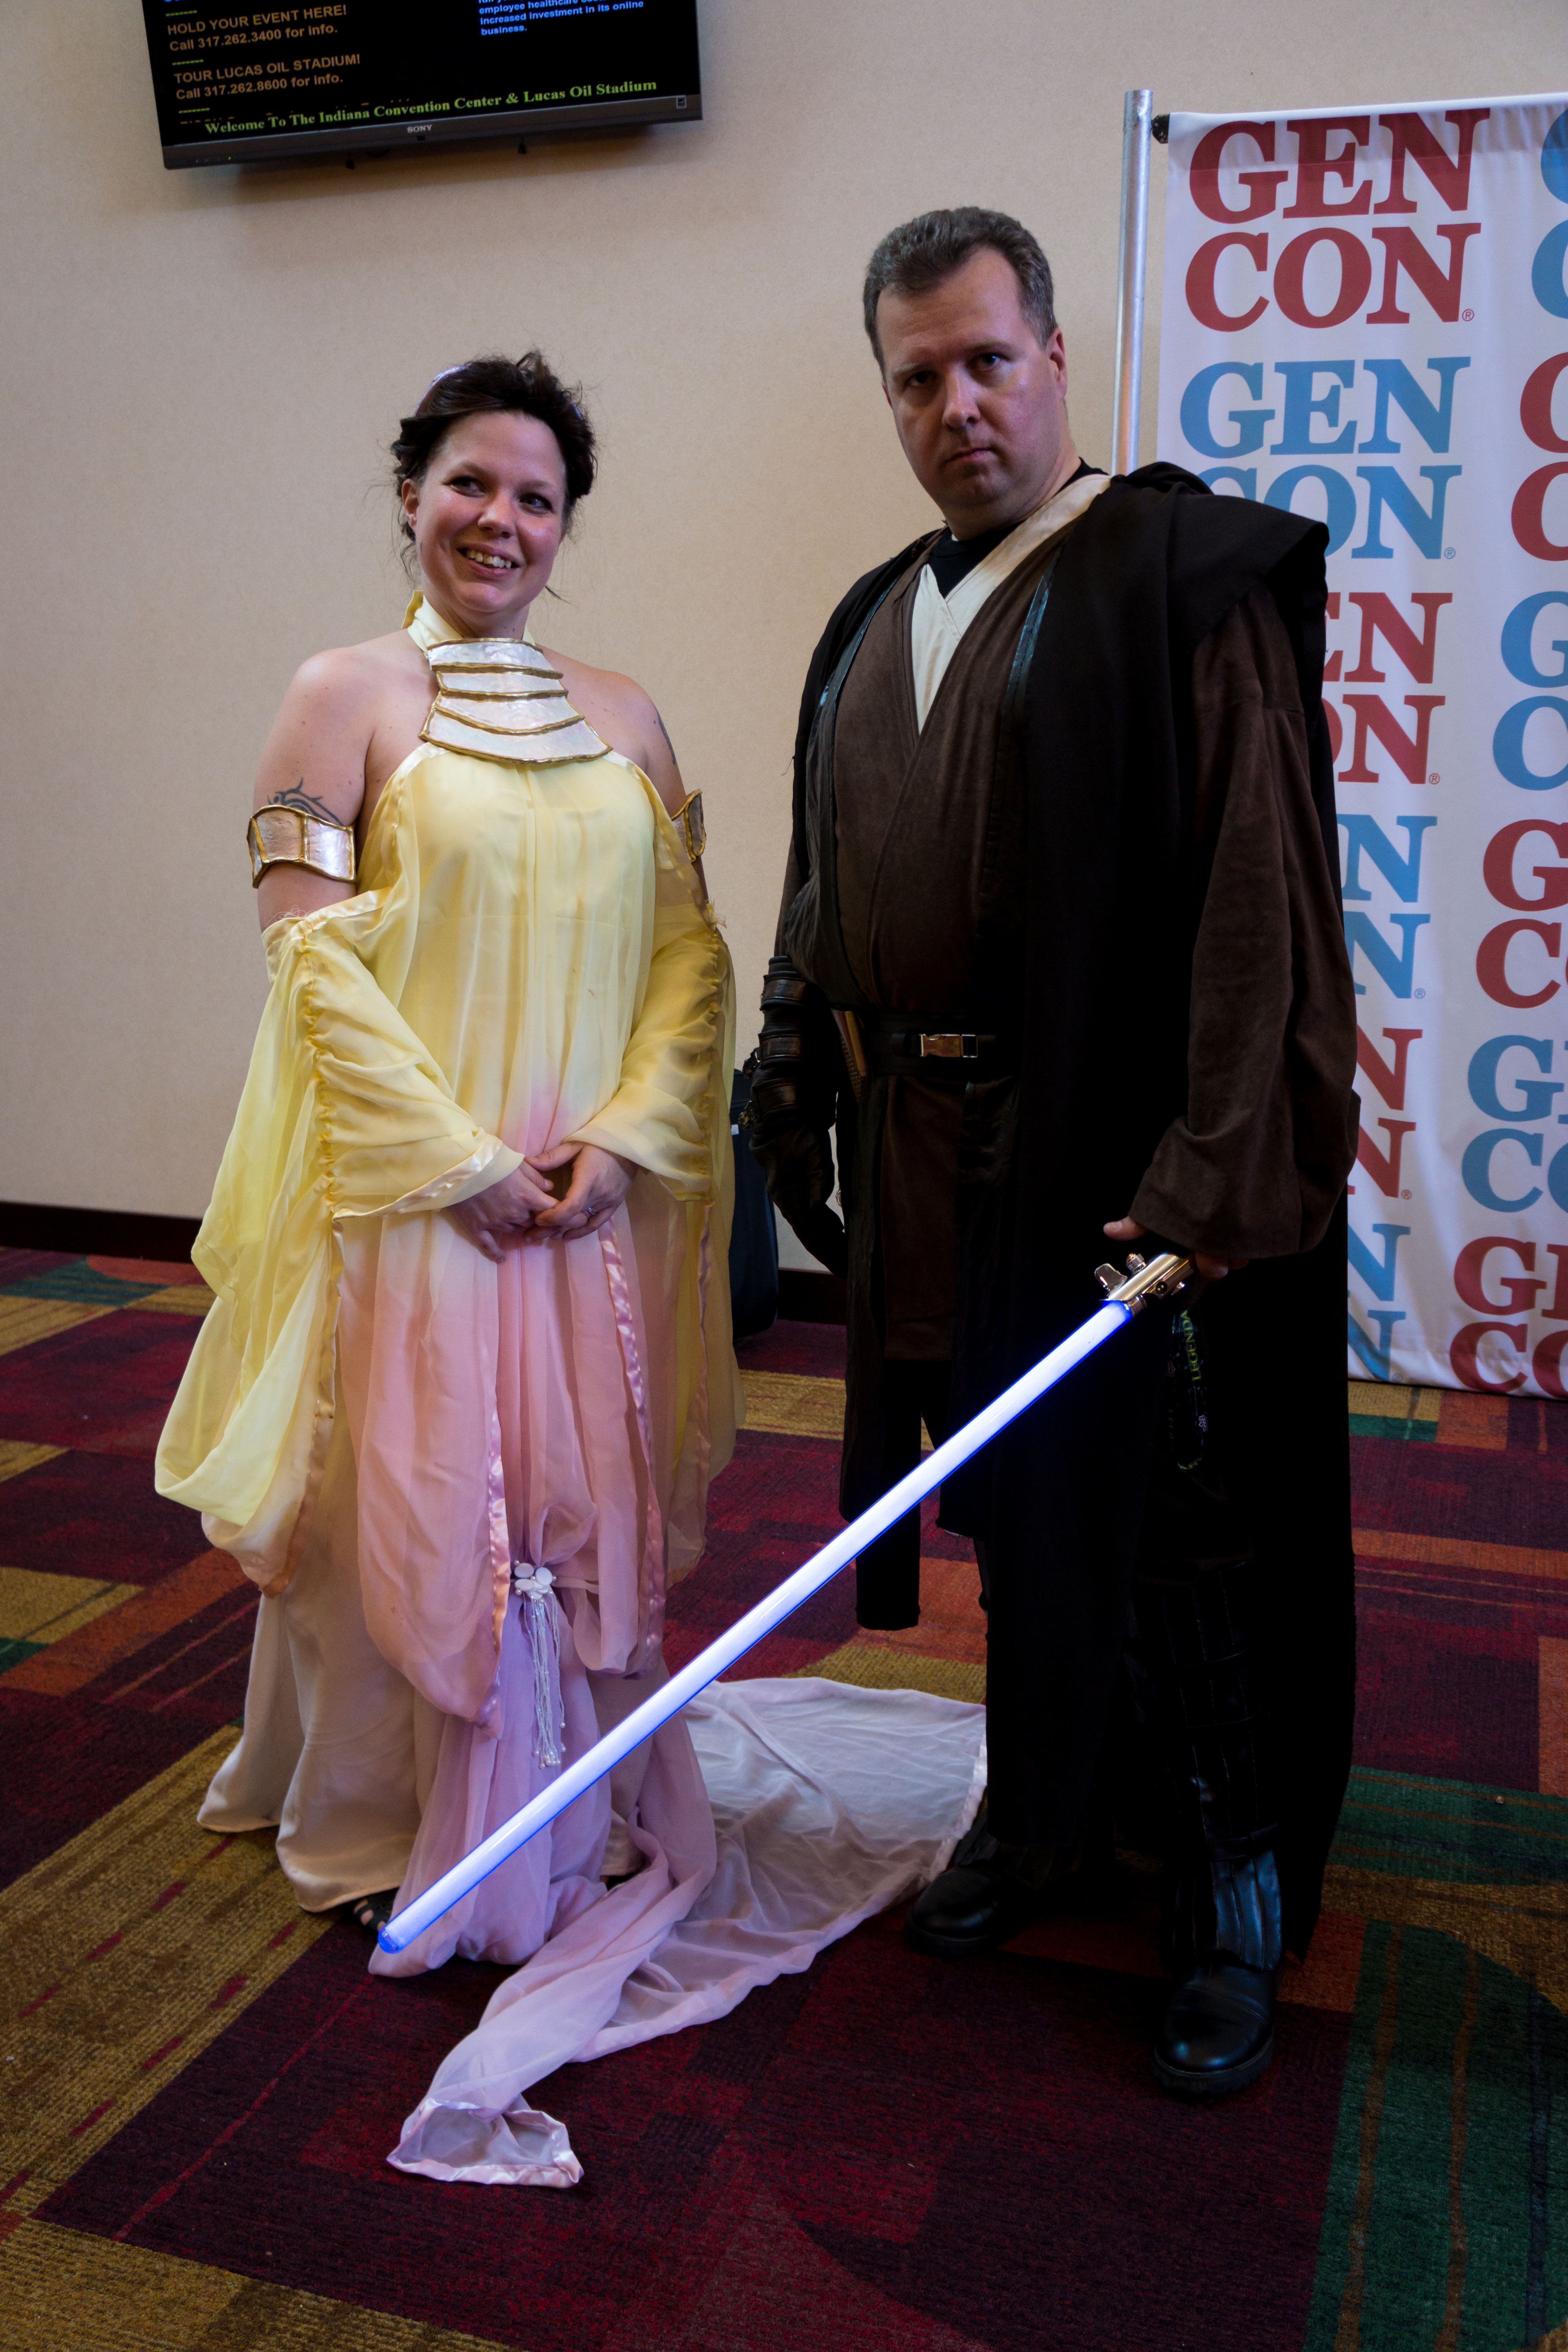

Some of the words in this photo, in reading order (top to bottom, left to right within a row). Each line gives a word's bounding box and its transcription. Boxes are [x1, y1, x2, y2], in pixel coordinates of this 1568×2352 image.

[168, 21, 205, 35] HOLD
[209, 16, 249, 29] YOUR
[253, 10, 299, 25] EVENT
[303, 4, 347, 19] HERE!
[479, 3, 526, 15] employee
[480, 13, 527, 25] increased
[529, 6, 583, 20] investment
[584, 5, 595, 14] in
[597, 4, 610, 13] its
[612, 0, 644, 11] online
[170, 38, 194, 51] Call
[198, 29, 281, 47] 317.262.3400
[285, 28, 305, 38] for
[309, 24, 338, 35] info.
[481, 24, 527, 36] business.
[174, 70, 212, 83] TOUR
[216, 64, 263, 79] LUCAS
[267, 62, 290, 73] OIL
[293, 54, 360, 70] STADIUM!
[176, 88, 200, 99] Call
[204, 78, 287, 96] 317.262.8600
[291, 77, 310, 87] for
[314, 73, 343, 85] info.
[205, 122, 264, 134] Welcome
[268, 117, 287, 127] To
[289, 114, 315, 125] The
[319, 110, 370, 123] Indiana
[374, 101, 450, 117] Convention
[454, 96, 502, 109] Center
[506, 93, 519, 104] &
[523, 91, 566, 102] Lucas
[570, 85, 592, 97] Oil
[596, 81, 657, 95] Stadium
[407, 124, 432, 133] SONY
[1189, 108, 1490, 224] GEN
[1185, 223, 1481, 332] CON
[1180, 356, 1472, 459] GEN
